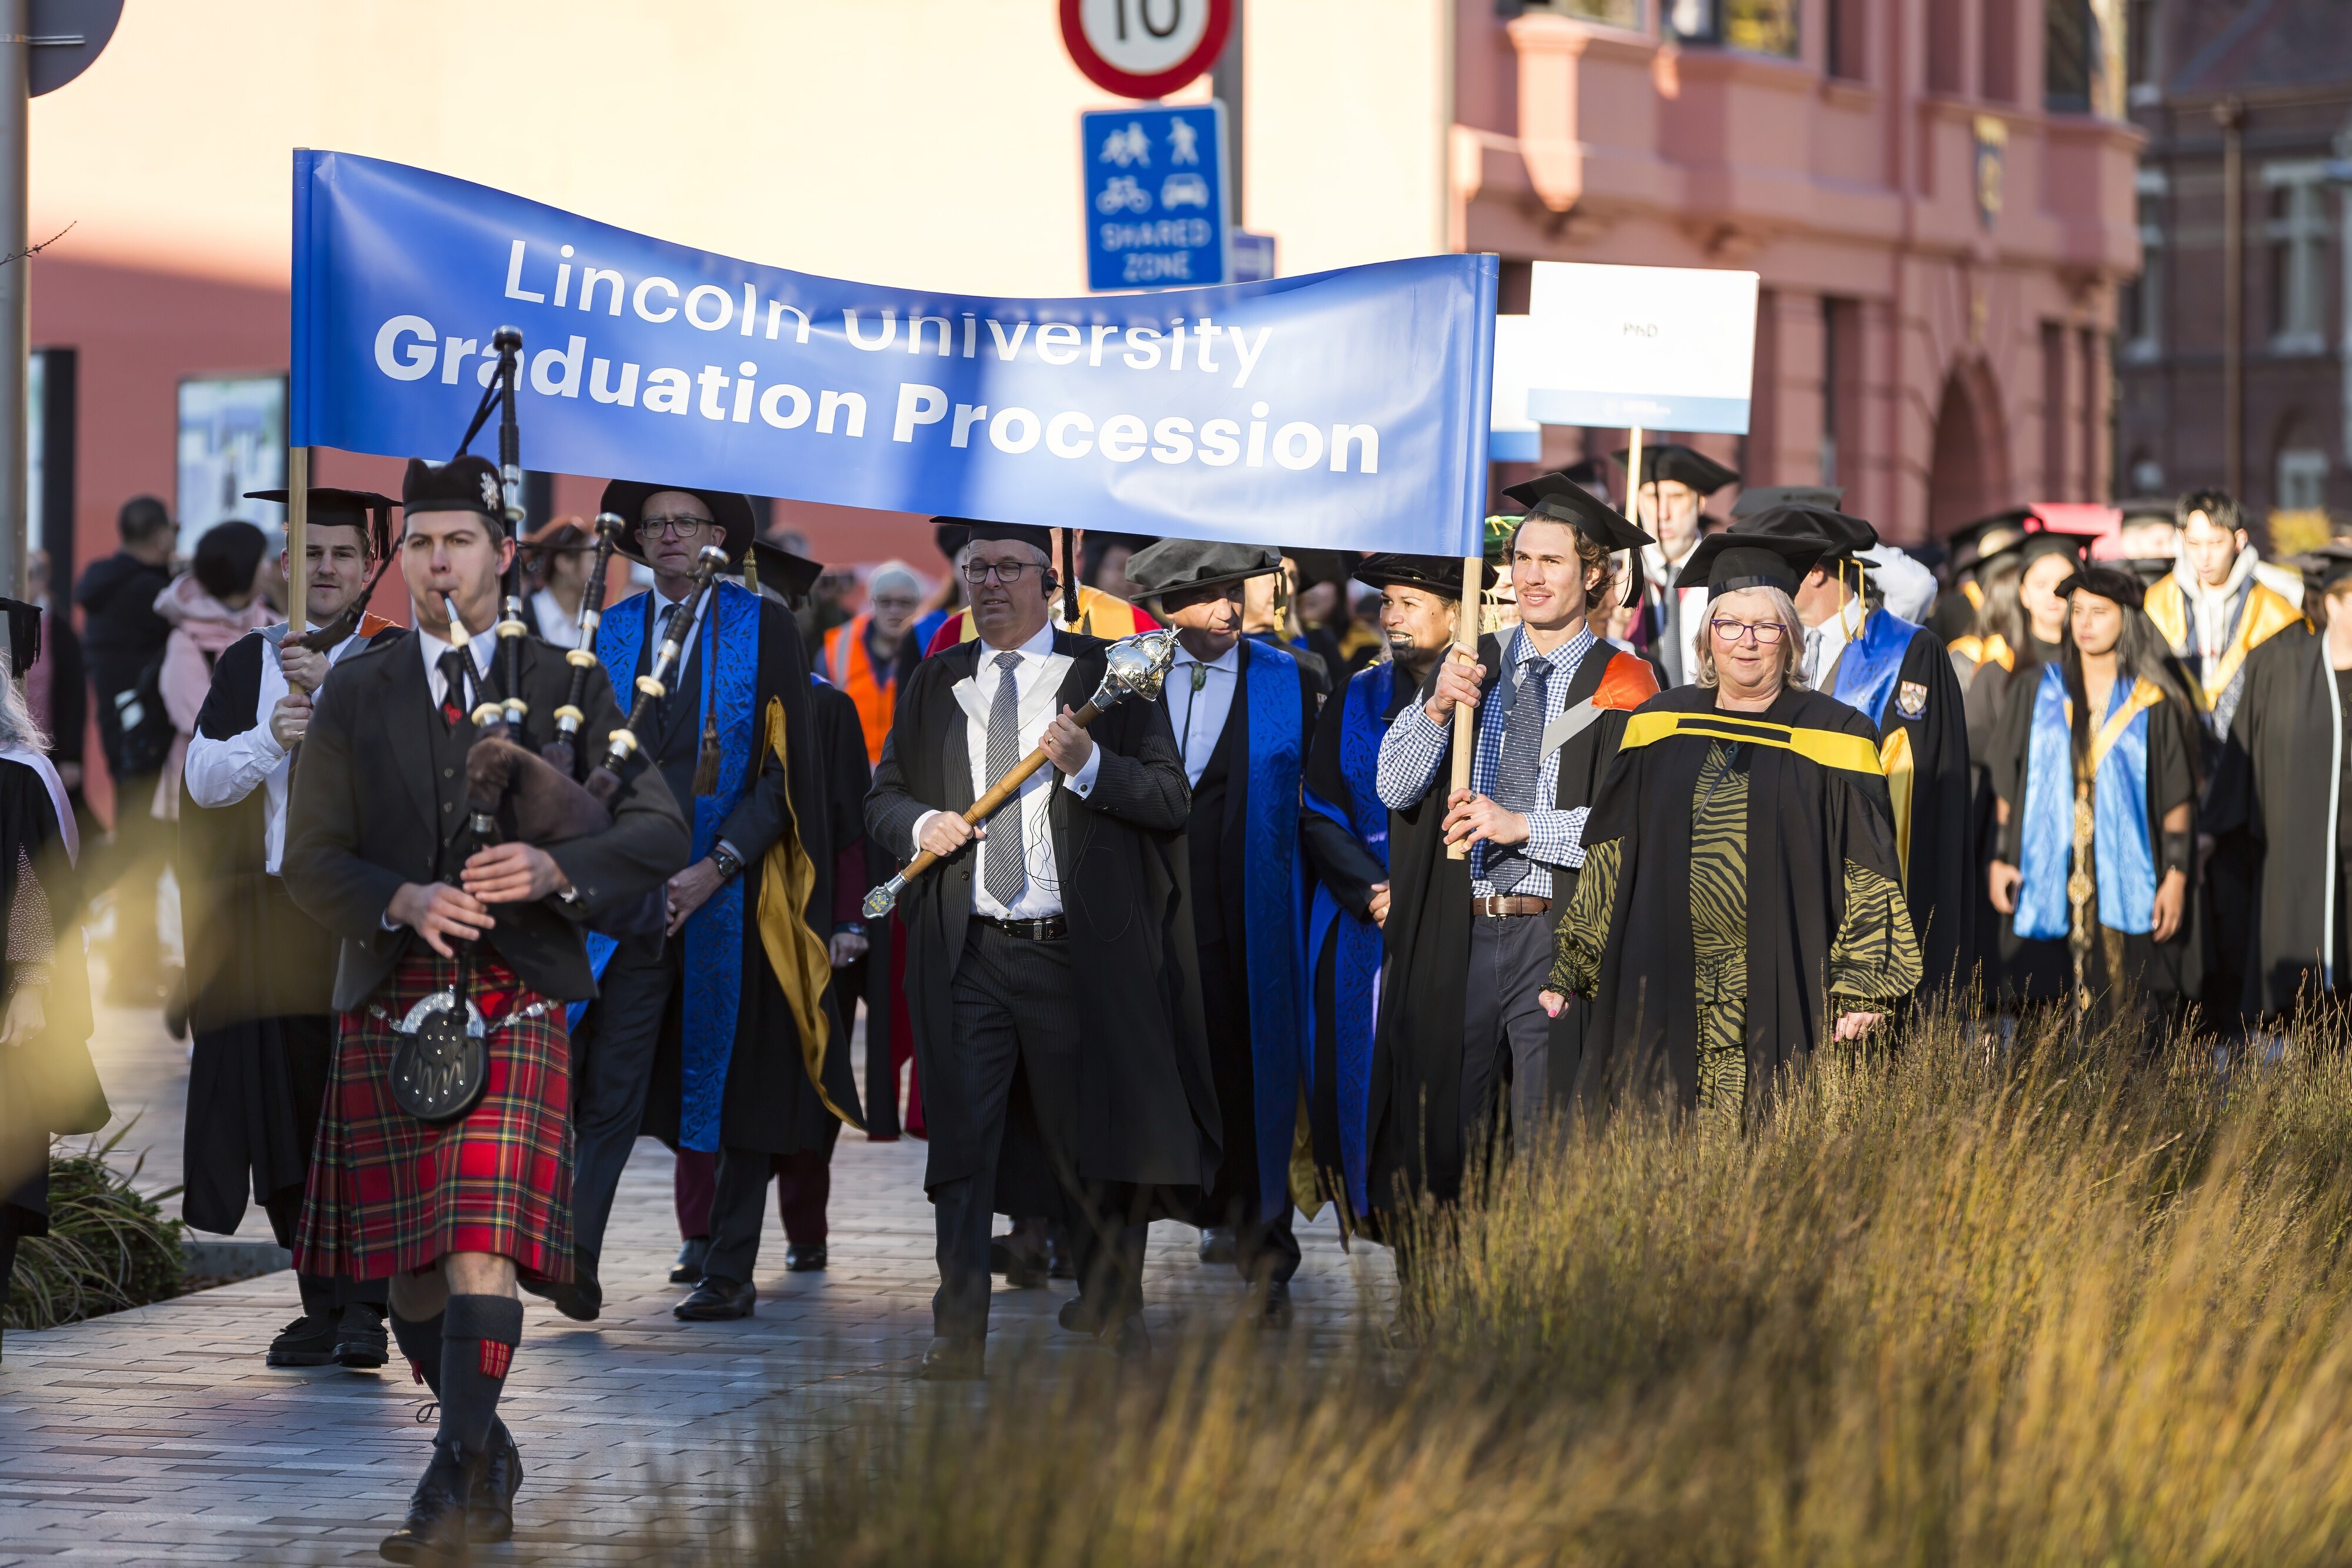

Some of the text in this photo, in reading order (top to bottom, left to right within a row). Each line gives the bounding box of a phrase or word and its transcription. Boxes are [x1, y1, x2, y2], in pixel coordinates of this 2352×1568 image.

[1113, 0, 1182, 41] 10
[1100, 218, 1212, 252] SHARED
[1123, 251, 1194, 282] ZONE
[504, 239, 1272, 388] Lincoln University
[374, 315, 1379, 474] Graduation Procession
